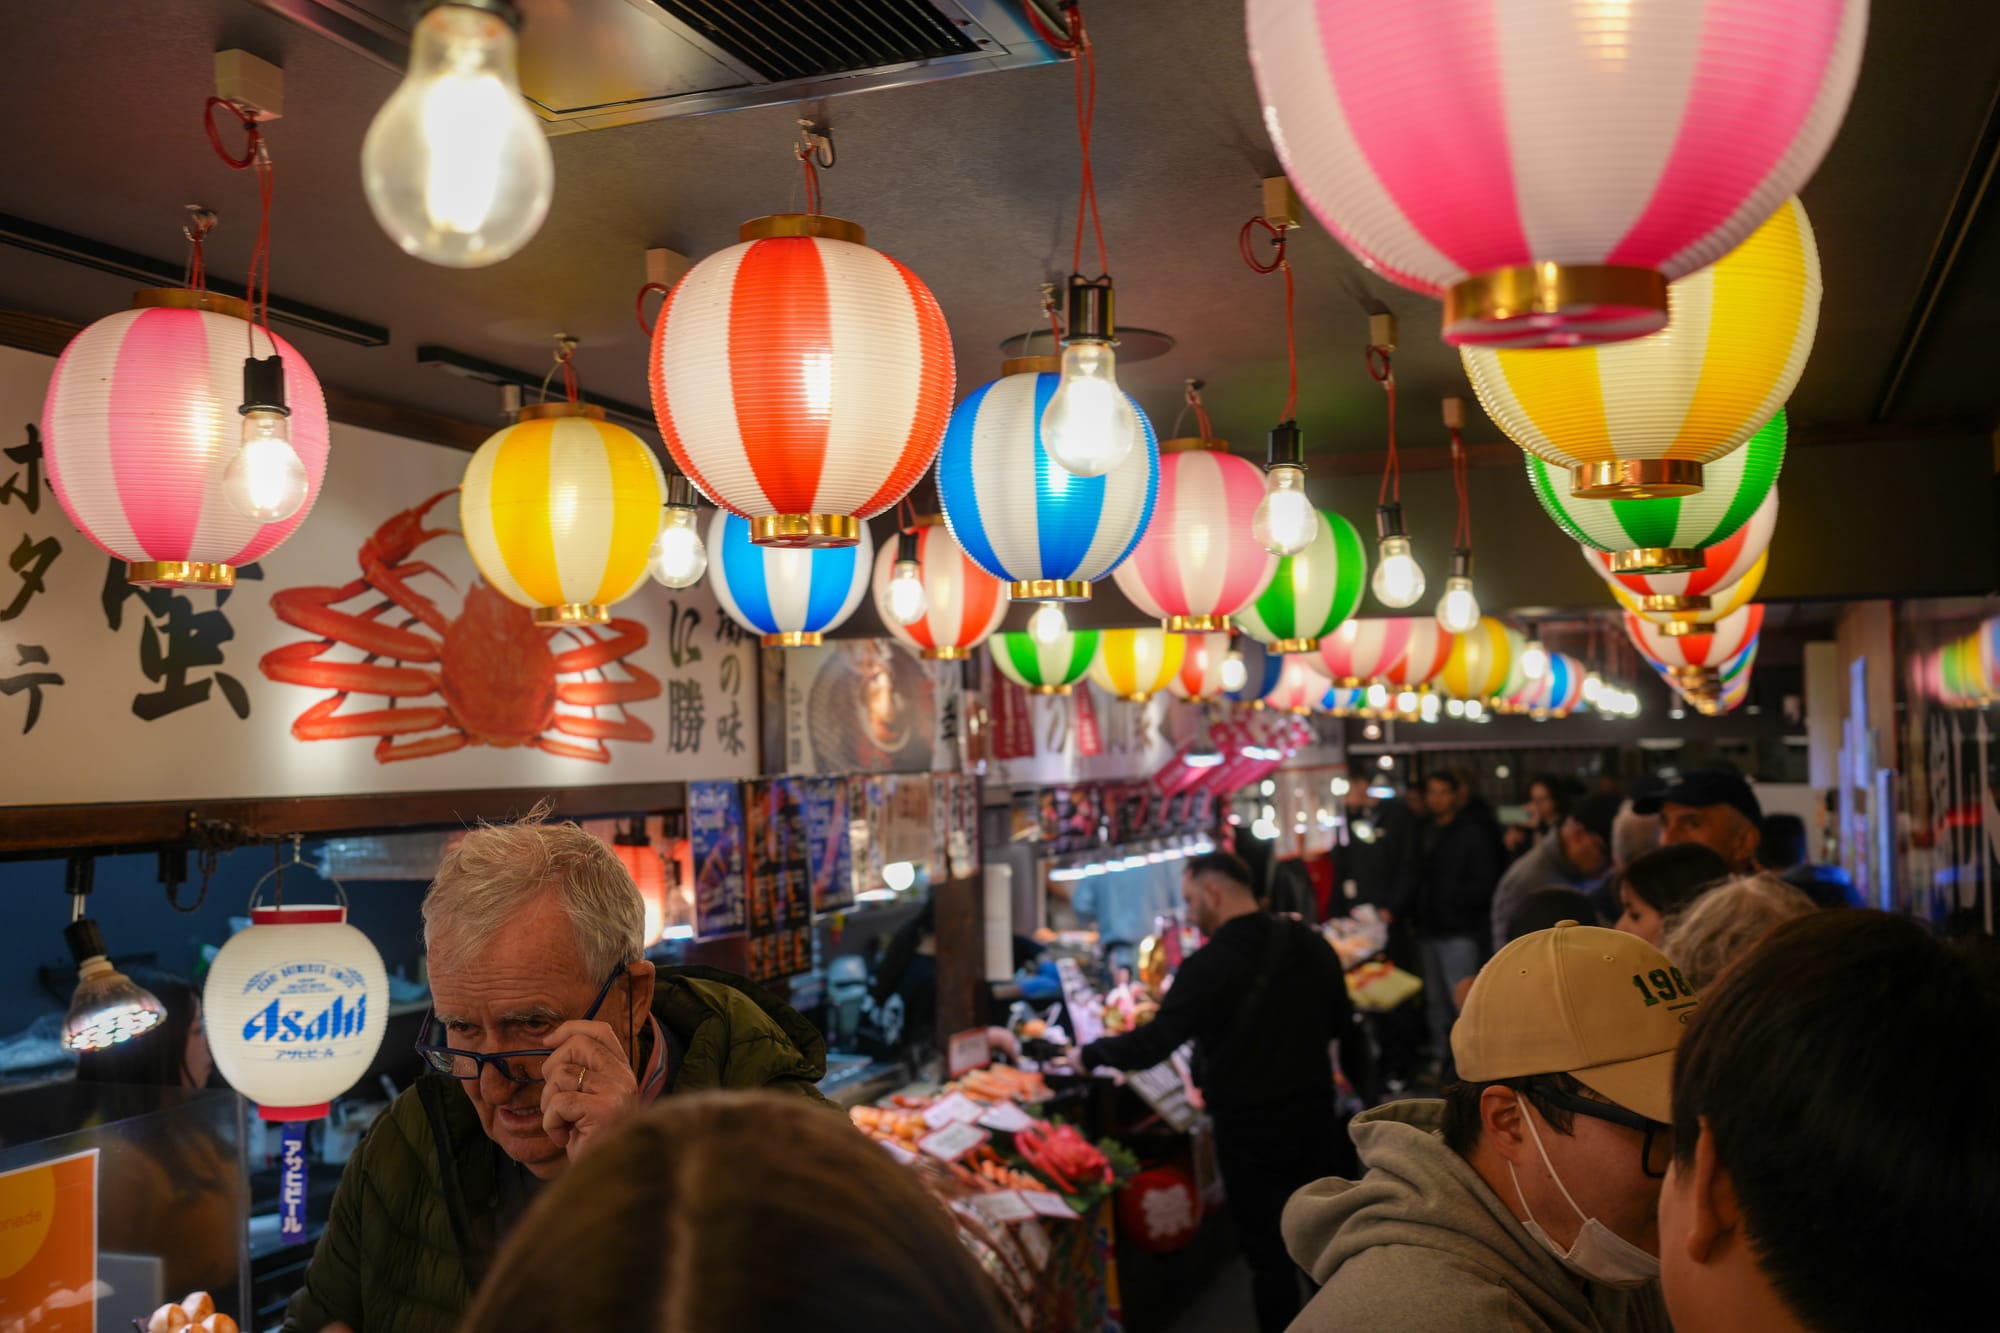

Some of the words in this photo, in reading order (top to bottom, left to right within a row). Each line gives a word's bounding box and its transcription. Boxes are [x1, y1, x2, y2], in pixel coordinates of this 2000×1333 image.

[242, 993, 367, 1042] Asahi
[283, 1139, 303, 1233] アサヒビール
